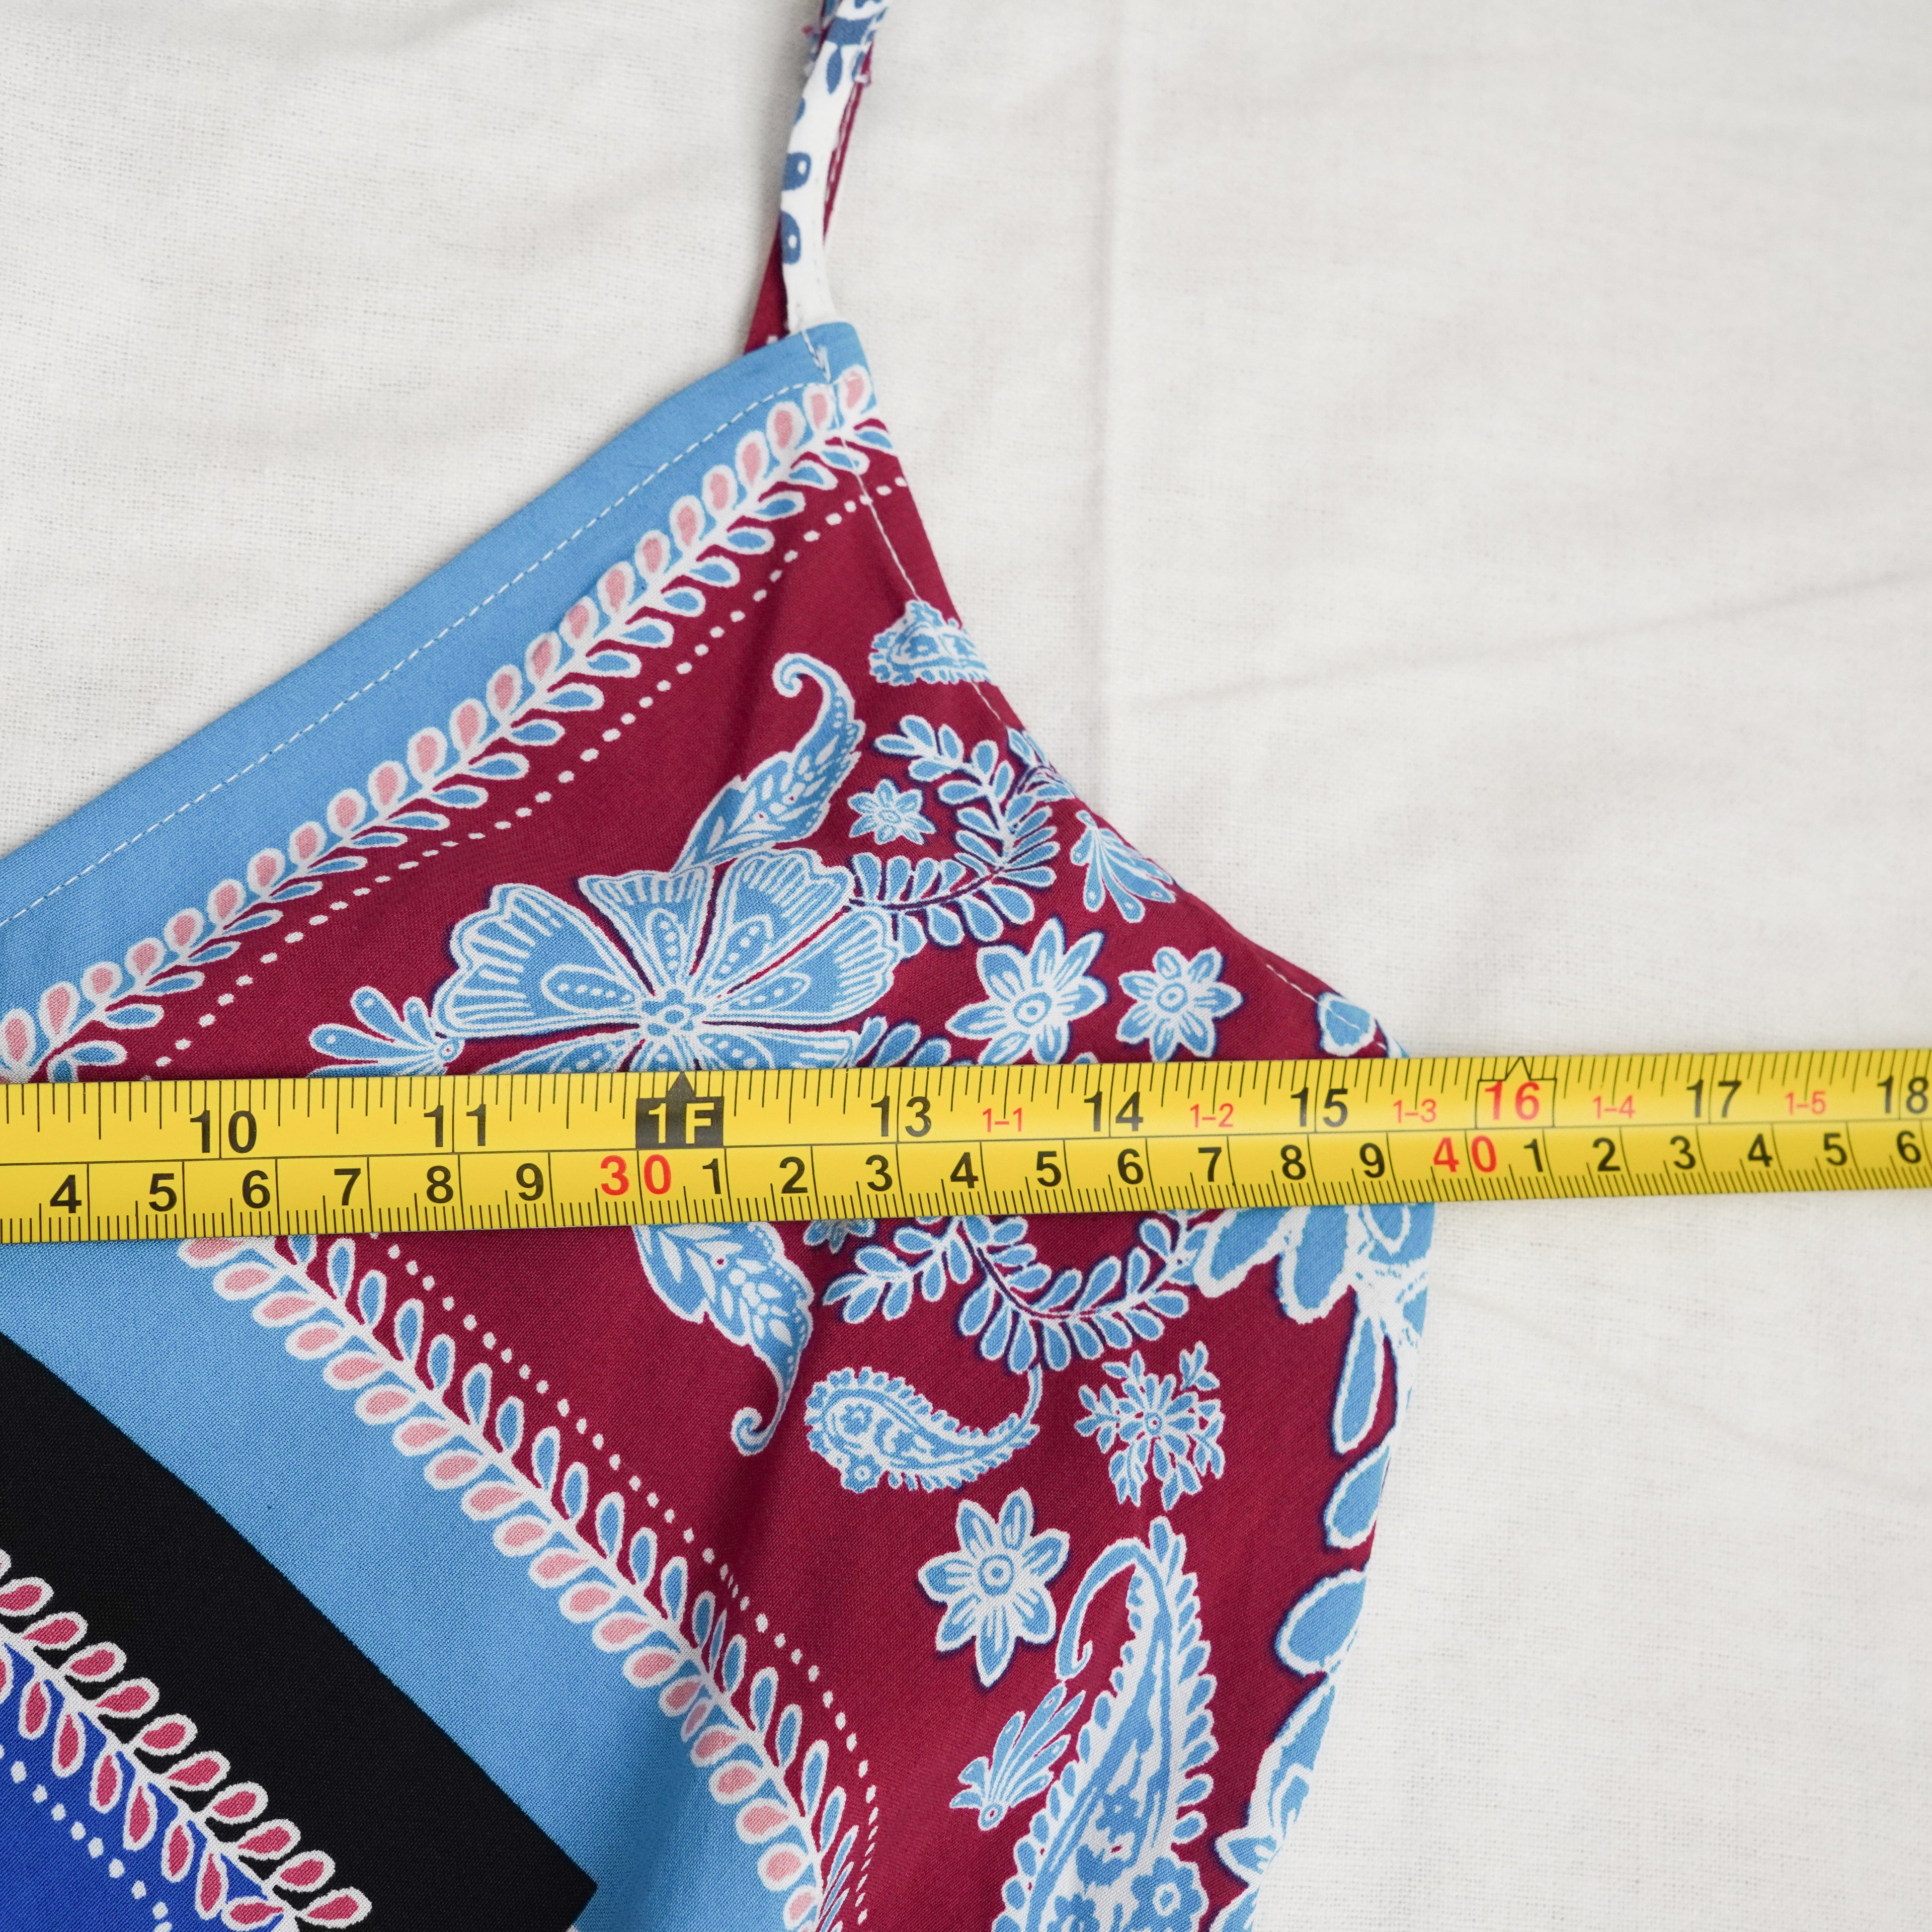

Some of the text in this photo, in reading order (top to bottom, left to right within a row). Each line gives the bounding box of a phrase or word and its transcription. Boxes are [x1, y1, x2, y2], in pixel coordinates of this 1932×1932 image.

[190, 1076, 1928, 1154] 10 11 1F 13 1-1 14 1-2 15 1-3 16 1-4 17 1-5 18
[49, 1175, 82, 1214] 4
[148, 1173, 177, 1212] 5
[242, 1170, 271, 1208] 6
[334, 1168, 361, 1206] 7
[426, 1166, 454, 1204] 8
[516, 1163, 543, 1201] 9
[702, 1158, 721, 1194] 1
[780, 1157, 808, 1194] 2
[865, 1155, 893, 1192] 3
[950, 1152, 978, 1189] 4
[1035, 1151, 1062, 1187] 5
[1117, 1148, 1144, 1184] 6
[1198, 1147, 1222, 1182] 7
[1280, 1145, 1306, 1180] 8
[1359, 1143, 1385, 1178] 9
[1524, 1139, 1544, 1172] 1
[1592, 1138, 1621, 1172] 2
[1669, 1136, 1696, 1170] 3
[1748, 1134, 1773, 1167] 4
[1823, 1133, 1847, 1166] 5
[1897, 1131, 1921, 1164] 6
